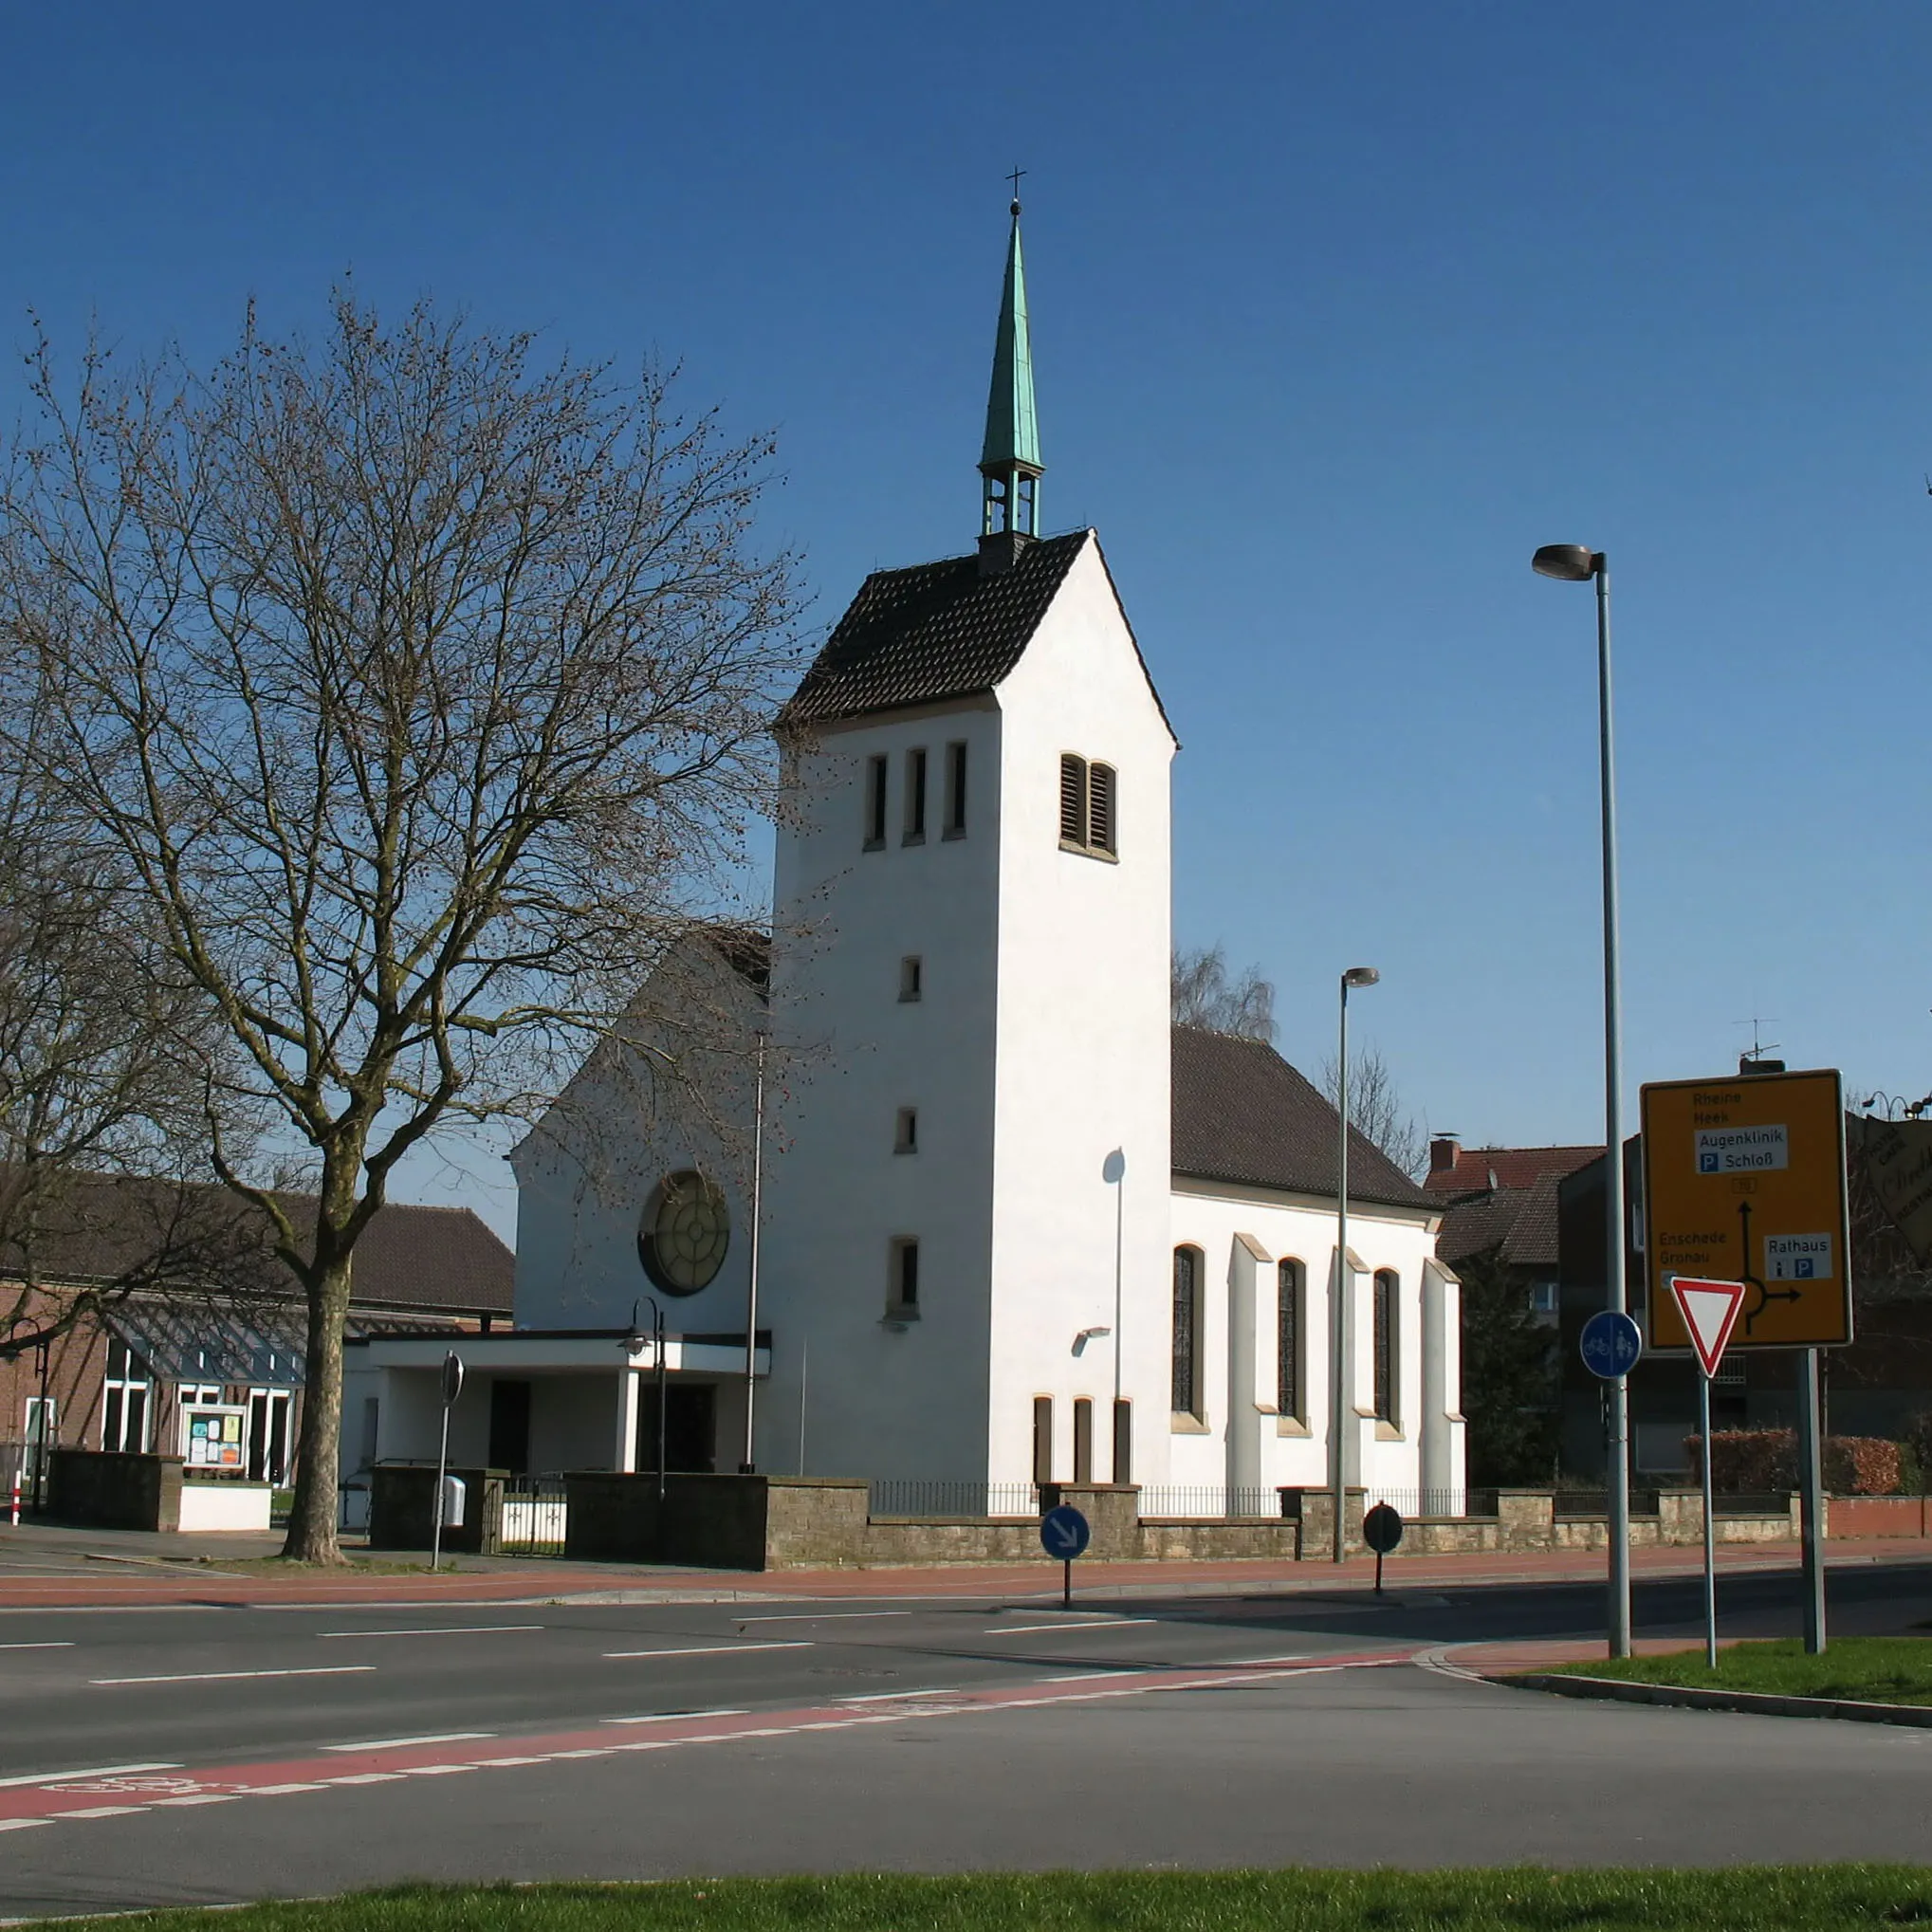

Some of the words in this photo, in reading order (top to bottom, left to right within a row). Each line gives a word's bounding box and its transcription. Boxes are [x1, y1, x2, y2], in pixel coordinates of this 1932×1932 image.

[1693, 1093, 1741, 1106] Rheine
[1694, 1112, 1729, 1125] Heek
[1701, 1129, 1784, 1150] Augenklinik
[1725, 1151, 1773, 1168] Schloß
[1660, 1231, 1727, 1245] Enschede
[1769, 1240, 1828, 1253] Rathaus
[1660, 1251, 1710, 1264] Gronau
